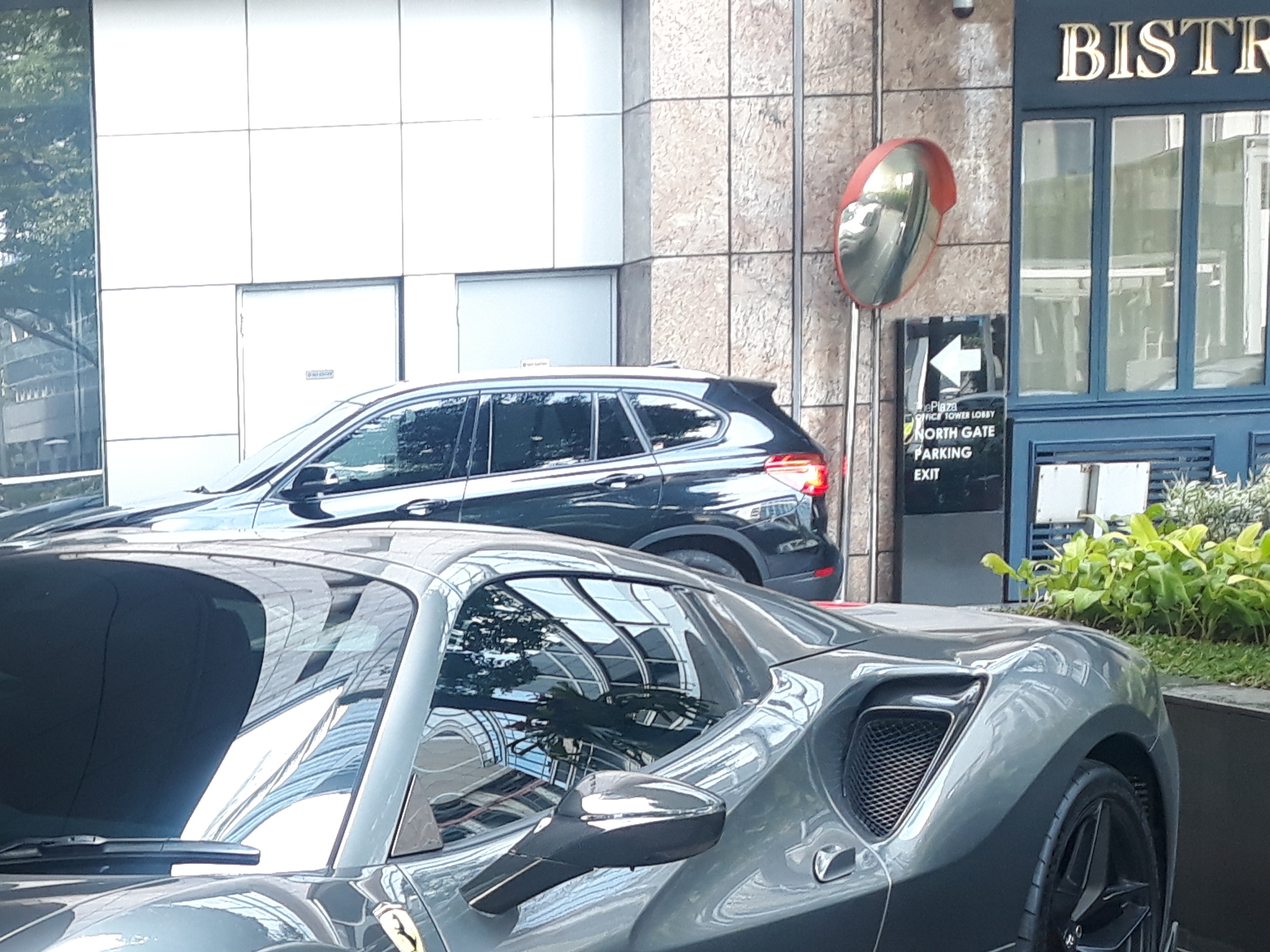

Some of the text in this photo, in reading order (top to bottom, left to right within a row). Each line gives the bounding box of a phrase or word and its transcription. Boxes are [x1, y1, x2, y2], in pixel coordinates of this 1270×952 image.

[1056, 15, 1270, 82] BISTR
[945, 411, 970, 420] TOWER
[971, 410, 995, 418] LOBBY
[914, 425, 995, 440] NORTH GATE
[914, 446, 972, 460] PARKING
[914, 467, 940, 480] EXIT
